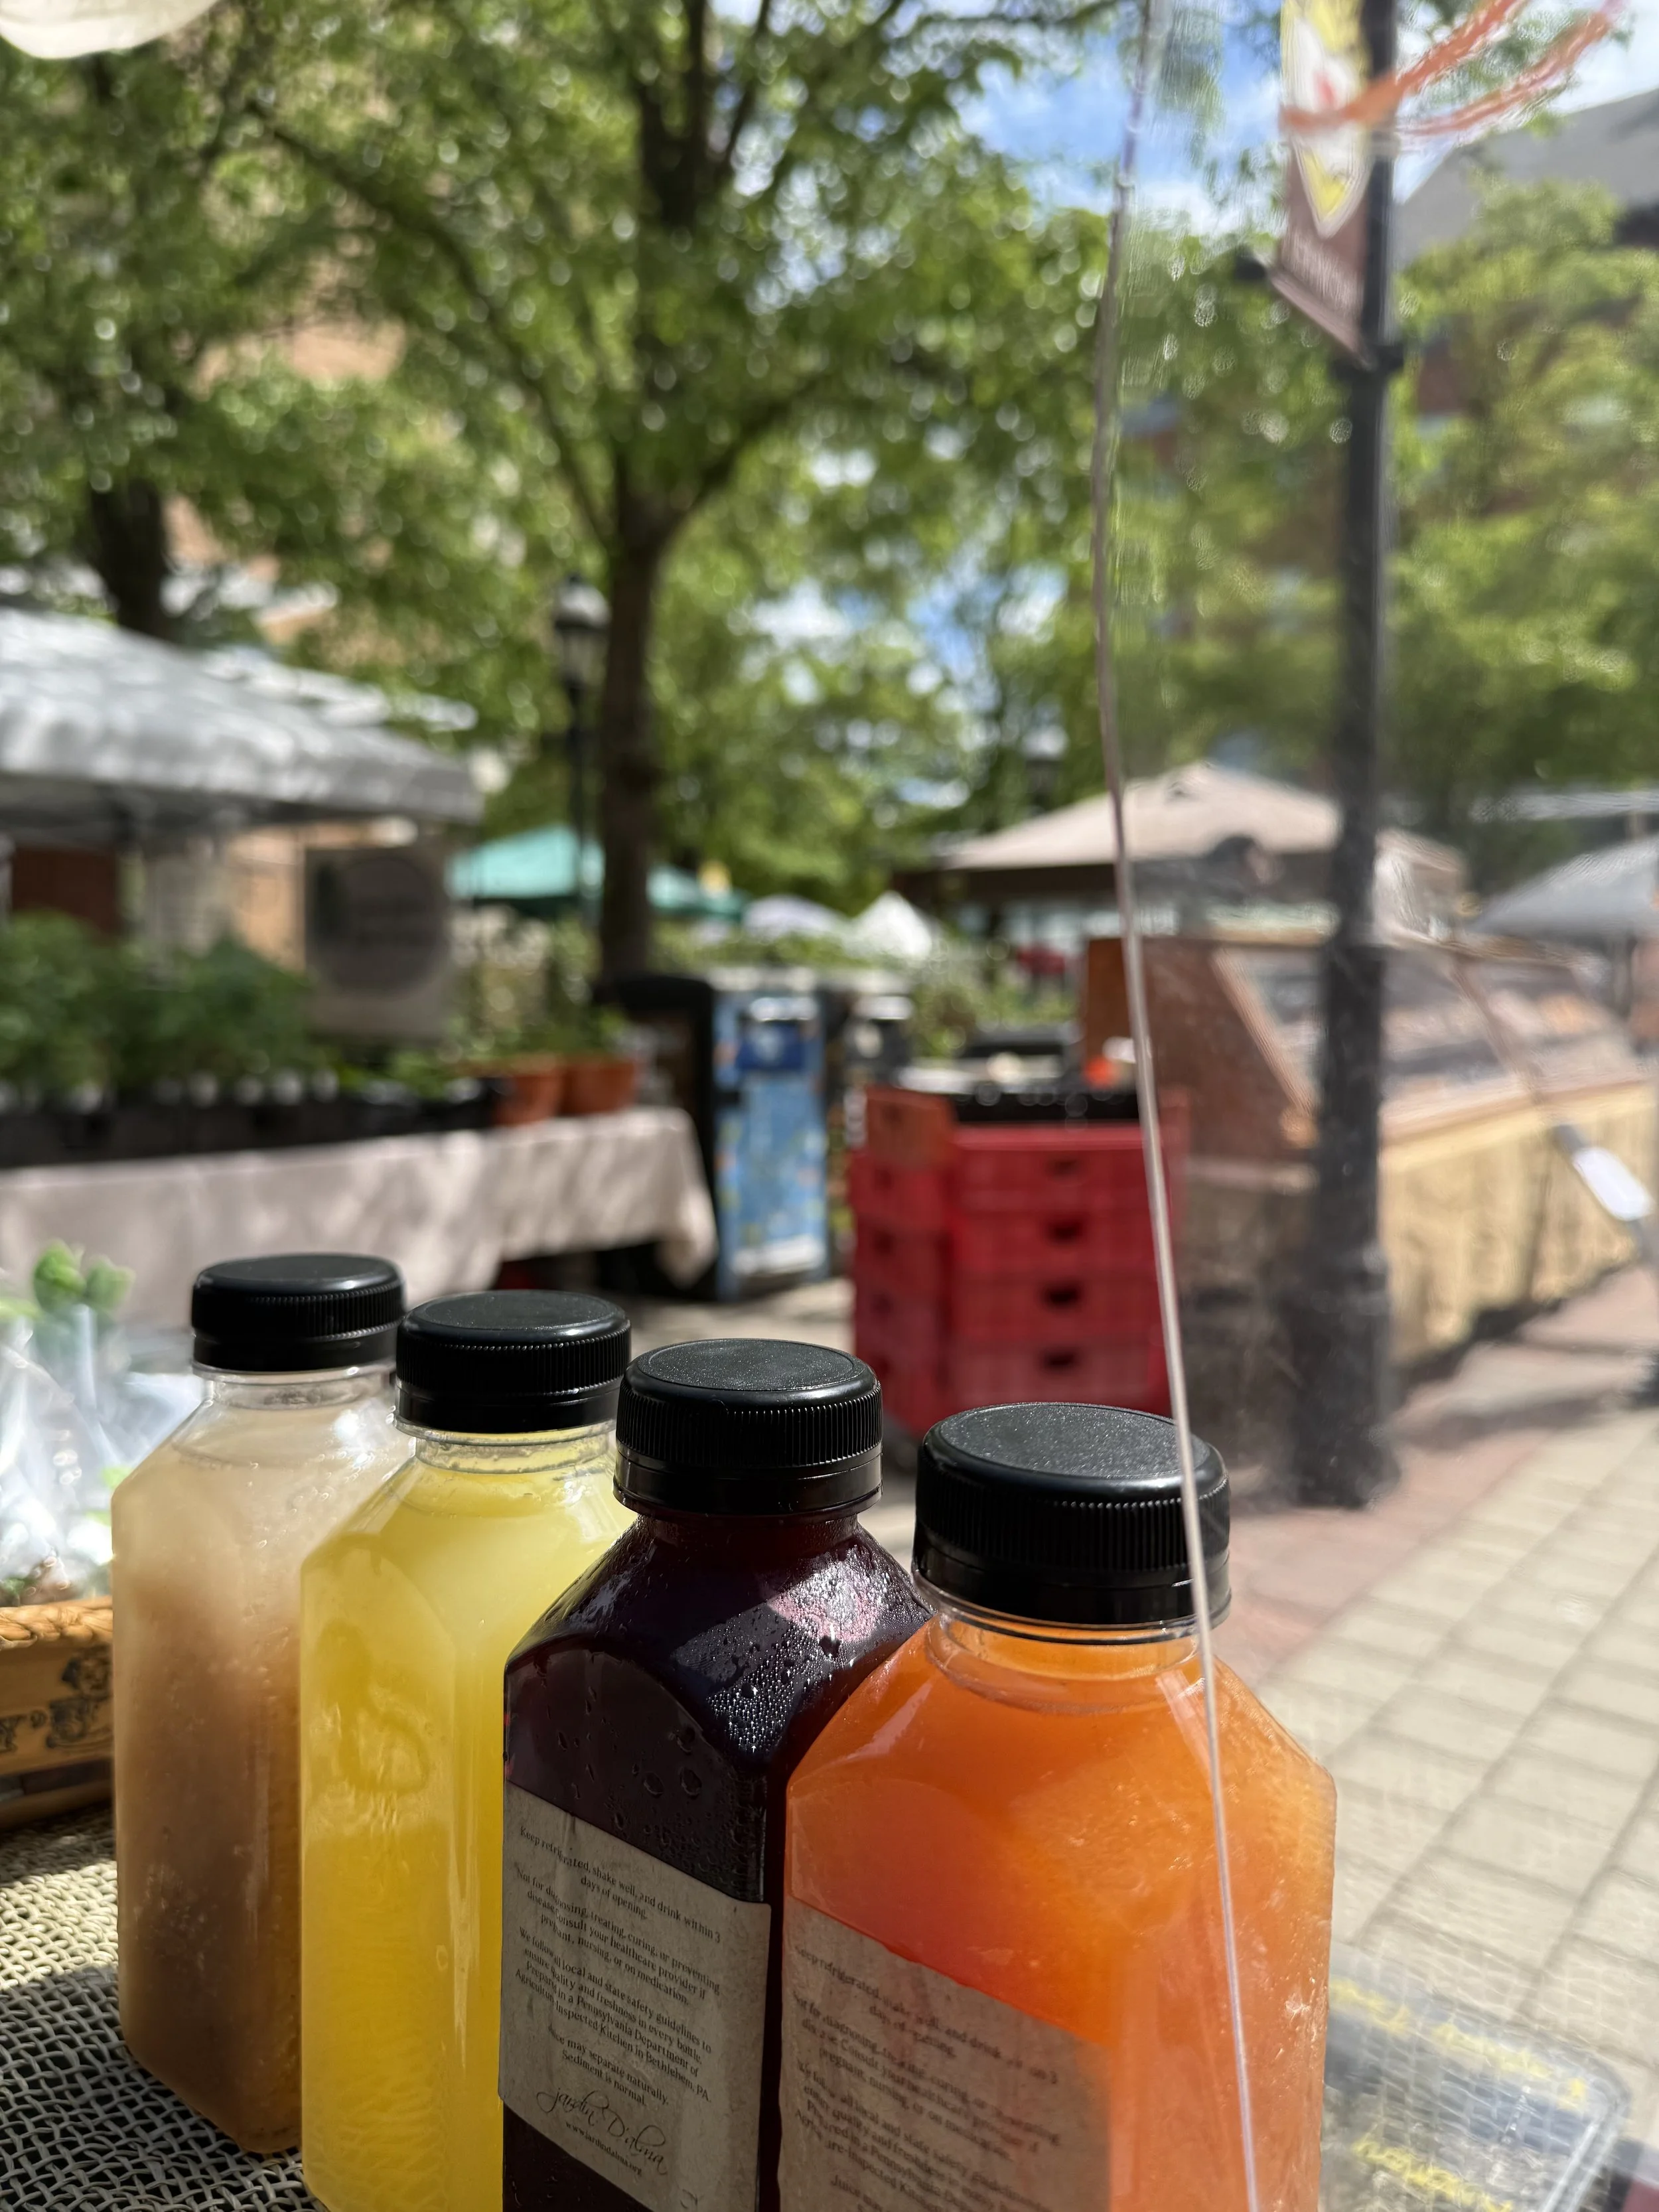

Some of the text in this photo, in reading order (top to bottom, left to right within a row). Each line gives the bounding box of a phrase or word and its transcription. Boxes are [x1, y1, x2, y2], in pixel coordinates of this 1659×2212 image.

[520, 1825, 540, 1847] Keep
[541, 1839, 591, 1875] refrigrated,
[592, 1866, 617, 1889] shake
[640, 1891, 656, 1909] and
[658, 1900, 682, 1922] drink
[684, 1915, 714, 1940] within
[715, 1930, 721, 1945] 3
[581, 1875, 601, 1894] days
[601, 1887, 612, 1900] of
[516, 1866, 530, 1886] Not
[532, 1877, 545, 1893] for
[659, 1951, 671, 1964] or
[672, 1956, 721, 1998] preventing
[555, 1907, 587, 1933] Consult
[589, 1925, 609, 1944] your
[610, 1933, 657, 1972] healthcare
[658, 1964, 699, 1995] provider
[699, 1986, 707, 2002] if
[613, 1956, 624, 1968] or
[625, 1961, 636, 1977] on
[519, 1925, 531, 1943] We
[532, 1935, 554, 1958] follow
[562, 1958, 586, 1980] local
[587, 1972, 604, 1988] and
[605, 1978, 626, 2002] state
[626, 1995, 654, 2020] safety
[656, 2012, 701, 2047] guidelines
[702, 2039, 713, 2055] to
[524, 1947, 550, 1971] ensure
[577, 1982, 595, 1999] and
[597, 1989, 637, 2025] freshness
[638, 2013, 647, 2030] in
[648, 2023, 674, 2047] every
[558, 1986, 567, 2002] in
[567, 1994, 575, 2005] a
[576, 1992, 634, 2037] Pennsylvania
[634, 2028, 689, 2071] Department
[689, 2063, 701, 2079] of
[561, 2048, 604, 2080] Sediment
[605, 2071, 613, 2085] is
[567, 2039, 587, 2057] may
[588, 2048, 626, 2079] separate
[599, 2022, 634, 2054] Kitchen
[634, 2043, 644, 2061] in
